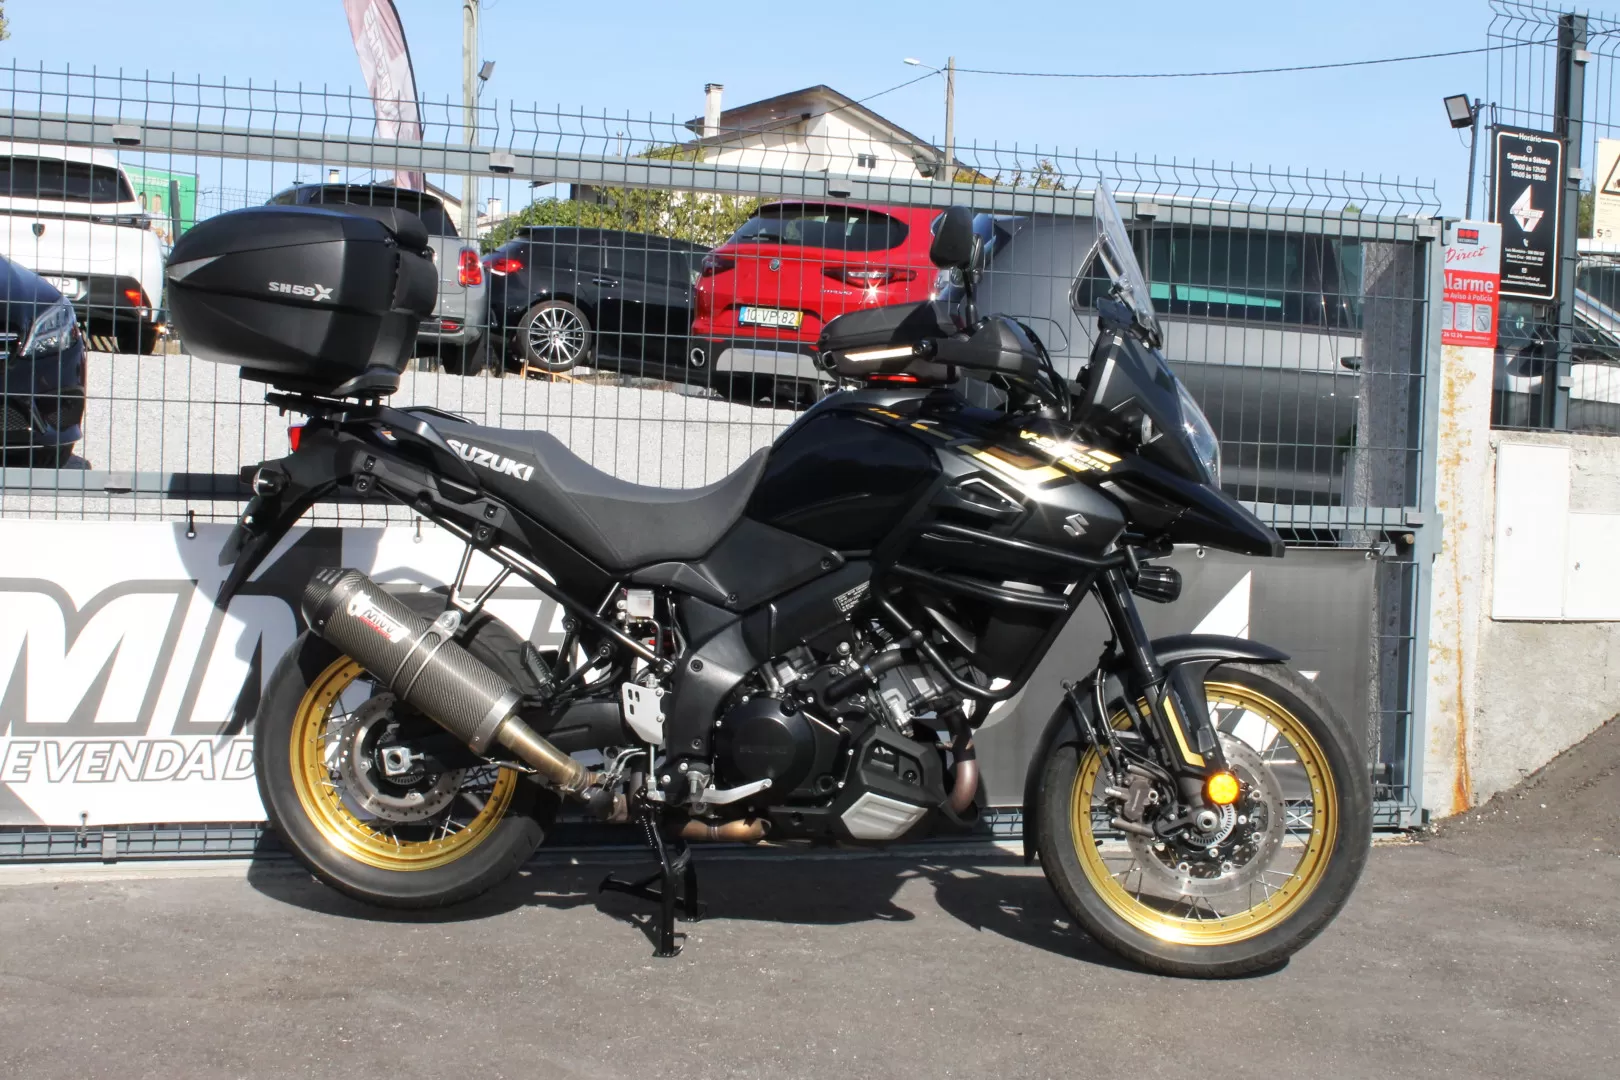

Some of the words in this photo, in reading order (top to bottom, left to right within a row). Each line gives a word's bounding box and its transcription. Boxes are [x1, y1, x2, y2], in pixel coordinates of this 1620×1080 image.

[1445, 246, 1489, 263] Direct
[268, 281, 334, 301] SH58X
[446, 439, 534, 482] SUZUKI
[44, 740, 215, 783] VENDA
